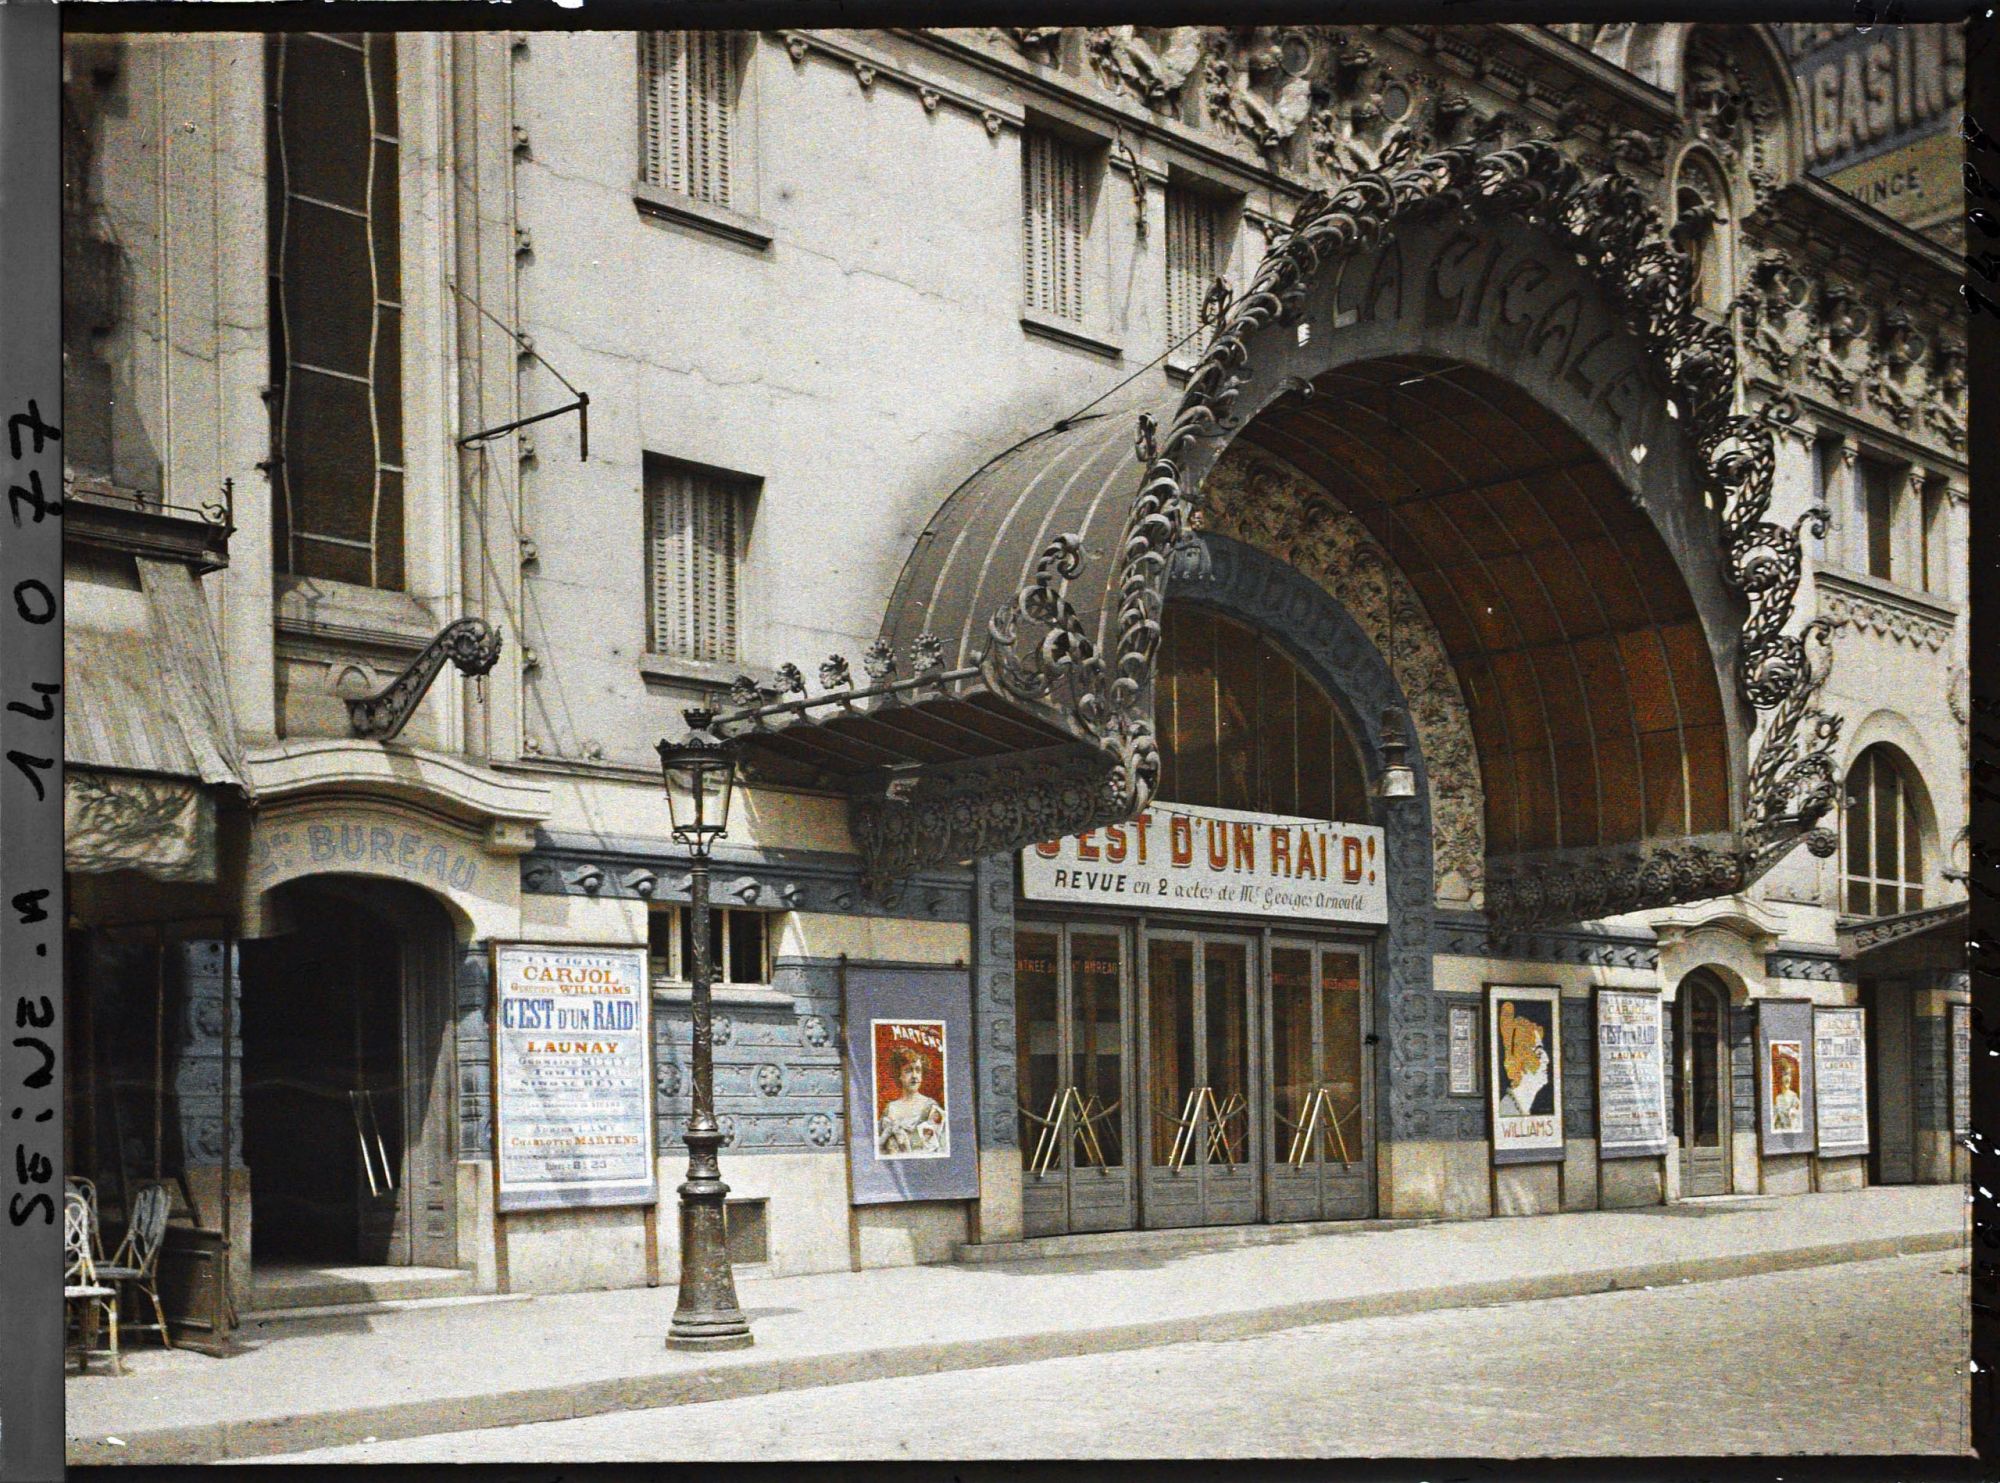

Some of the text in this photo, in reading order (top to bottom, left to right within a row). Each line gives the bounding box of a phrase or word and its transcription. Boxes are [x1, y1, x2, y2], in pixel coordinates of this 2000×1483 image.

[1036, 813, 1153, 864] EST
[1171, 815, 1255, 874] D'UN
[308, 823, 477, 891] BUREAU
[1055, 869, 1127, 893] REVUE
[1133, 881, 1150, 895] en
[1158, 878, 1169, 897] 2
[1174, 883, 1213, 900] actes
[1218, 884, 1236, 902] de
[1262, 887, 1313, 911] Georges
[522, 965, 620, 985] CARJOL
[559, 984, 632, 996] WILLIAMS
[503, 997, 640, 1031] C'EST D'UN RAID!
[526, 1040, 620, 1055] LAUNAY
[890, 1024, 944, 1053] MARTENS
[574, 1134, 640, 1147] MARTENS
[1501, 1119, 1555, 1138] WILLIAMS
